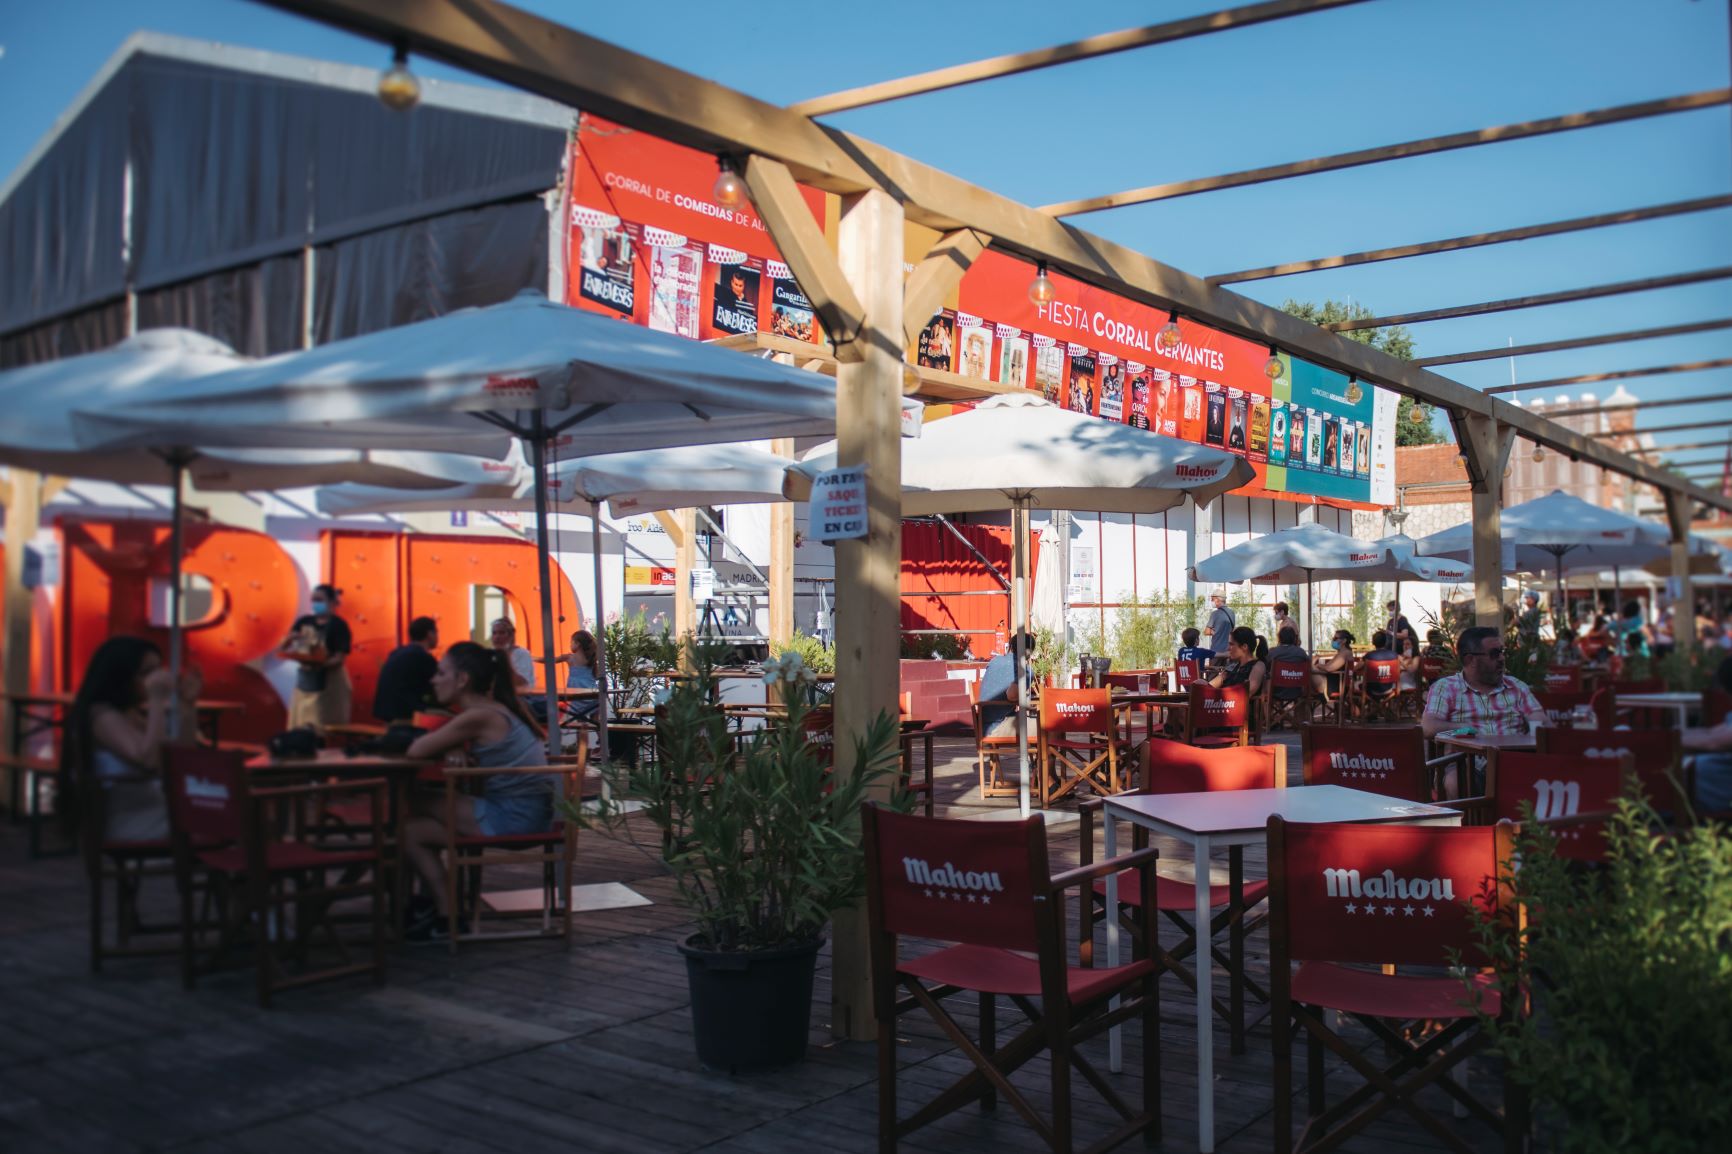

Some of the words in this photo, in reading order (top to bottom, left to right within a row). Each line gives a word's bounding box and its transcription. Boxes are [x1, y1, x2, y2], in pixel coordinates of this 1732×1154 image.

[605, 172, 653, 198] CORRAL
[656, 188, 671, 204] DE
[674, 194, 733, 222] COMEDIAS
[736, 213, 749, 227] DE
[752, 218, 768, 232] AL
[1038, 300, 1090, 333] FIESTA
[1175, 464, 1218, 477] Mahou
[1349, 553, 1379, 562] Mahou
[1181, 652, 1193, 661] 15
[1056, 703, 1095, 713] Mahou
[1204, 699, 1235, 708] Mahou
[1330, 751, 1395, 771] Mahou
[902, 855, 1004, 893] Mahou
[1322, 867, 1456, 901] Mahou
